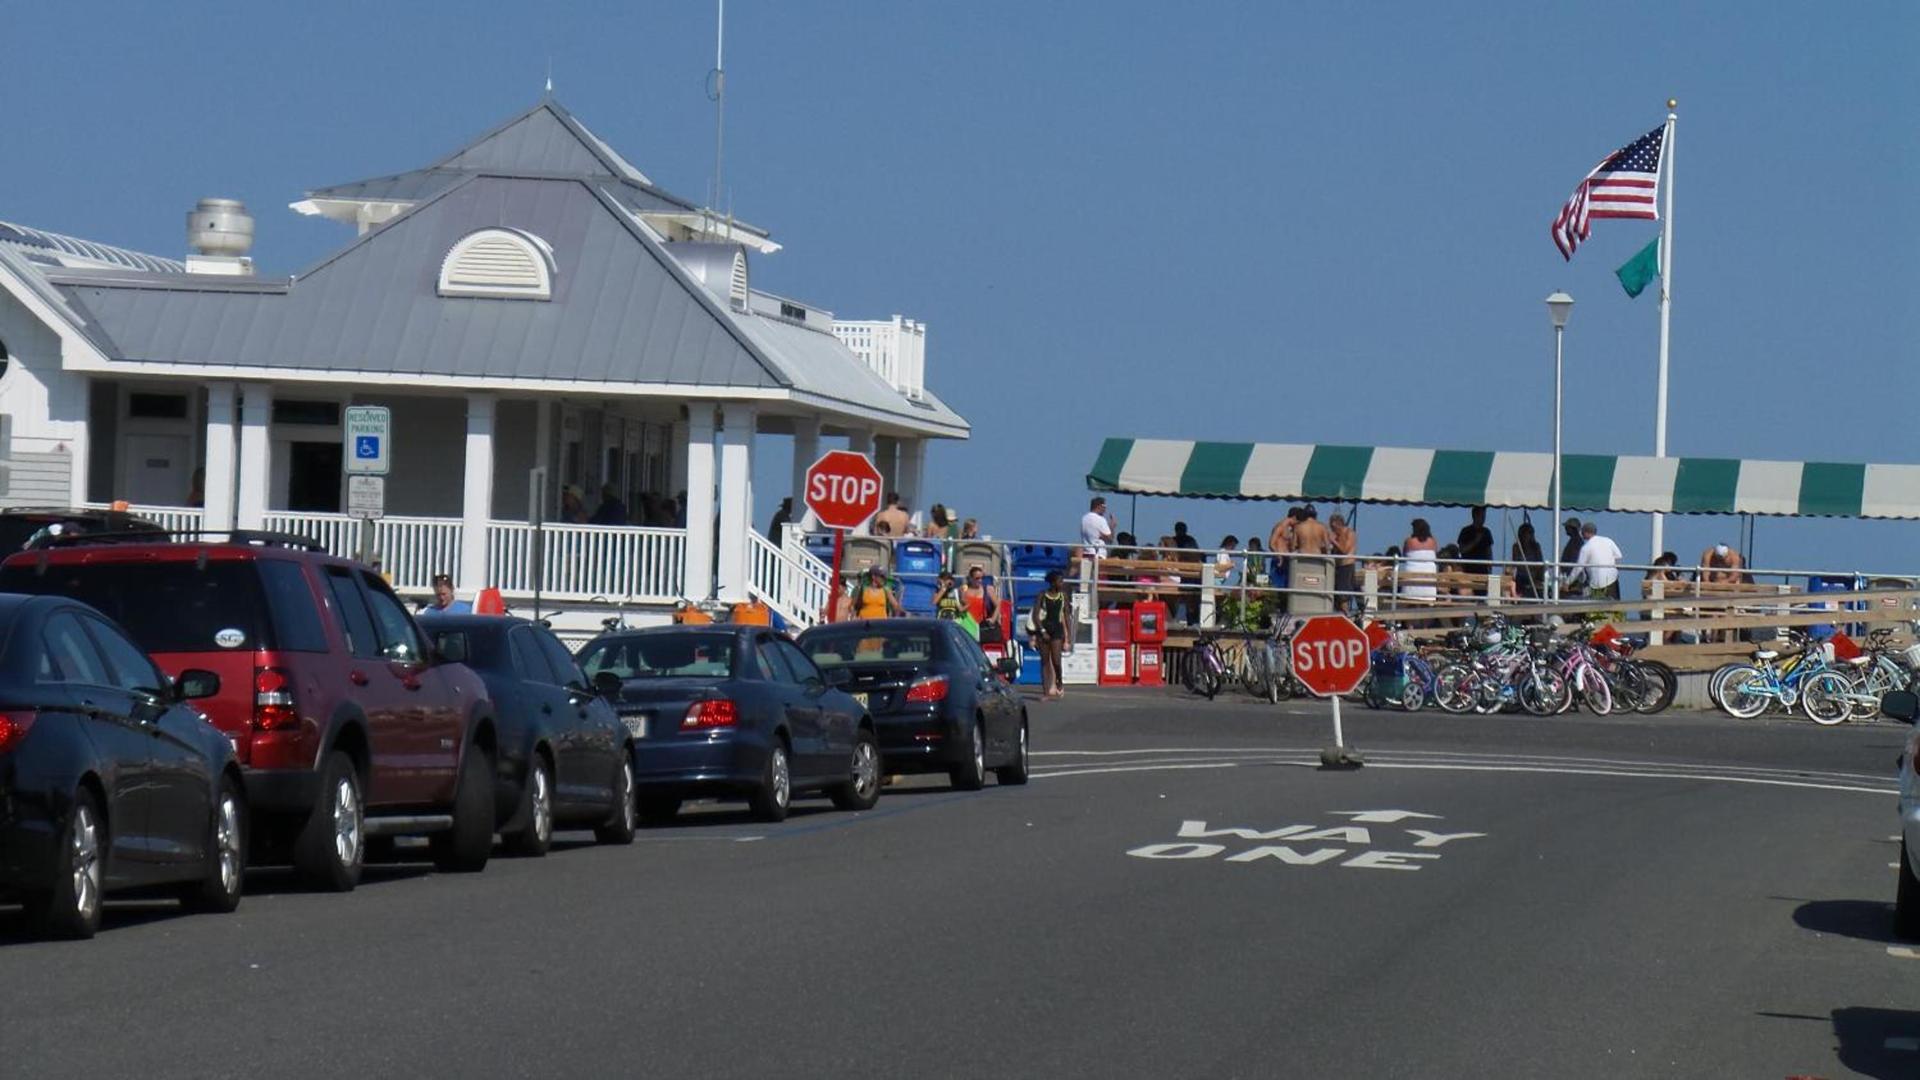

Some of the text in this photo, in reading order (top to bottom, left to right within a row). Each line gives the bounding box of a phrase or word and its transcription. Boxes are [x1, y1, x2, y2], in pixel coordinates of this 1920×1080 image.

[349, 413, 386, 422] RESERVED
[351, 425, 385, 433] PARKING
[810, 473, 877, 505] STOP
[1297, 639, 1363, 671] STOP
[1177, 820, 1487, 846] WAY
[1126, 843, 1441, 870] ONE
